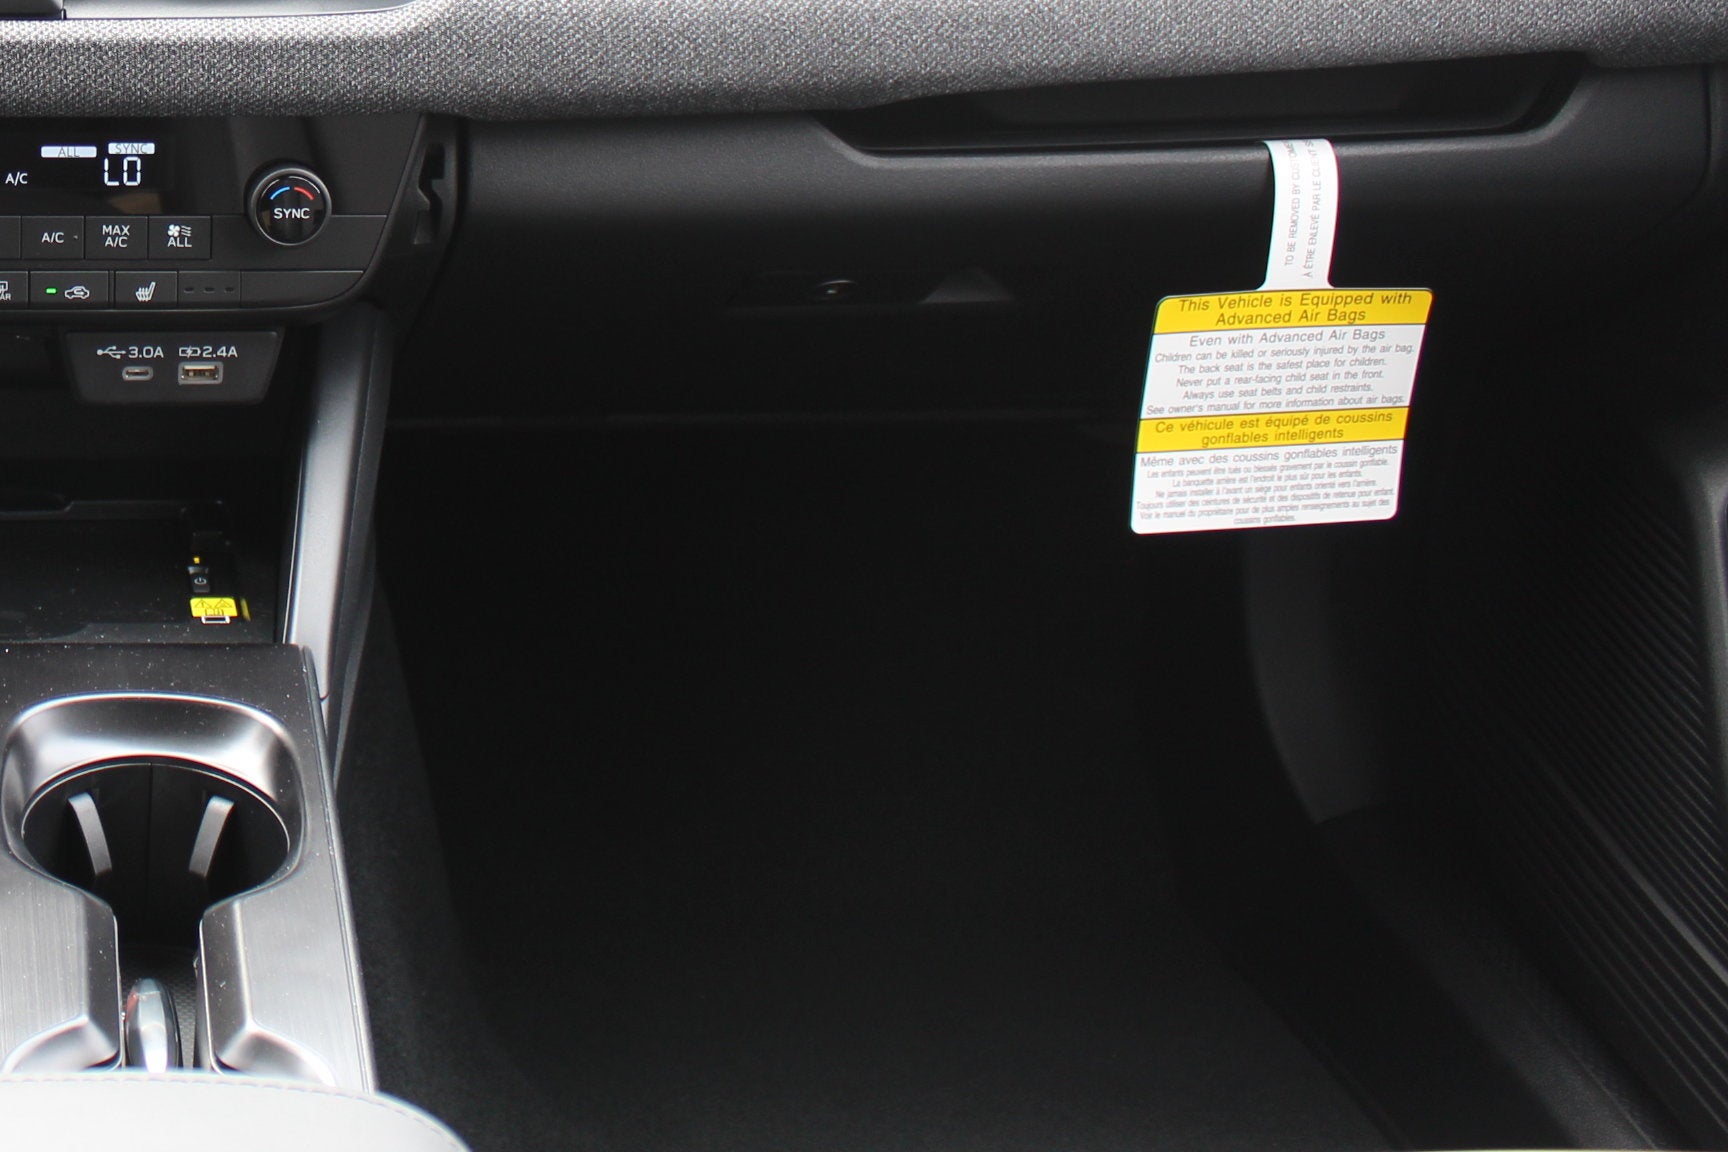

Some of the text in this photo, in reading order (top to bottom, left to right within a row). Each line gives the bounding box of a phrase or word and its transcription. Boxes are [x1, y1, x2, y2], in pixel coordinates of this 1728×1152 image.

[58, 146, 80, 158] ALL
[114, 143, 148, 154] SYNC
[5, 172, 28, 185] A/C
[274, 208, 310, 220] SYNC
[41, 232, 64, 244] A/C
[102, 225, 130, 236] MAX
[104, 236, 128, 248] A/C
[168, 236, 192, 248] ALL
[1179, 292, 1412, 312] This Vehicle is Equipped with
[1216, 308, 1366, 326] Advanced Air Bags
[1189, 329, 1386, 348] Even with Advanced Air Bags
[128, 346, 164, 359] 3.0A
[202, 346, 238, 359] 2.4A
[1154, 344, 1414, 363] Children can be killed or seriously injured by the air bag.
[1178, 357, 1386, 374] The back seat is the safest place for children.
[1176, 378, 1203, 388] Never
[1206, 377, 1221, 388] put
[1234, 374, 1282, 386] rear-facing
[1285, 373, 1306, 382] child
[1309, 372, 1330, 382] seat
[1332, 371, 1340, 380] in
[1344, 370, 1358, 380] the
[1362, 370, 1384, 379] front.
[1146, 405, 1164, 415] See
[1168, 404, 1204, 414] owner's
[1207, 402, 1240, 412] manual
[1244, 401, 1256, 410] for
[1259, 400, 1282, 409] more
[1285, 398, 1334, 408] information
[1338, 396, 1363, 405] about
[1366, 394, 1377, 404] air
[1155, 412, 1393, 434] Ce véhicule est équipé de coussins
[1202, 428, 1344, 448] gonflables intelligents
[1140, 445, 1398, 468] Même avec des coussins gonflables intelligents
